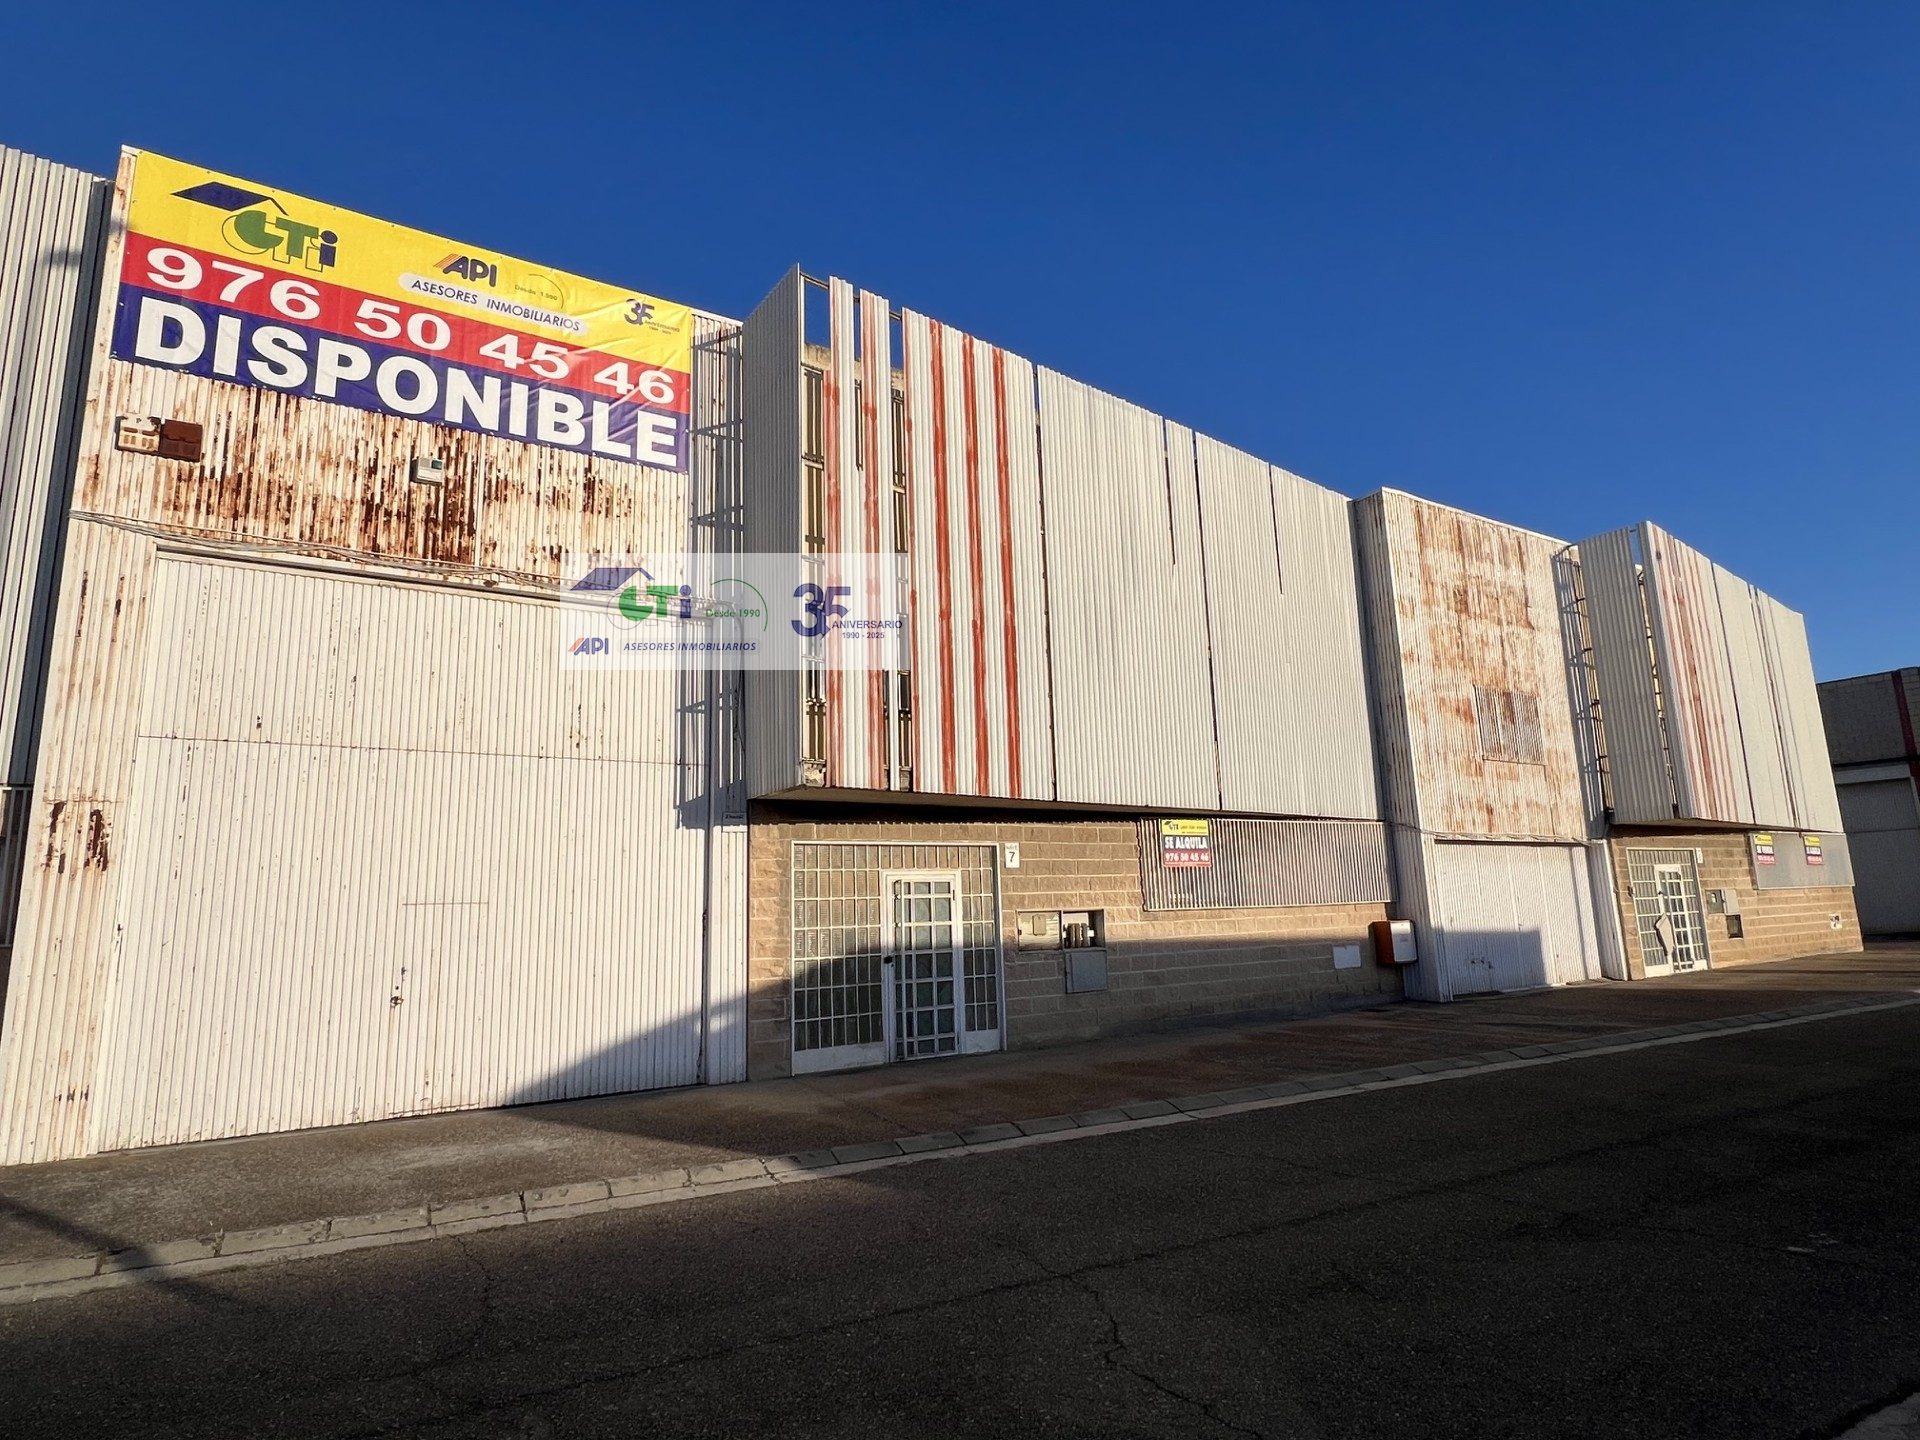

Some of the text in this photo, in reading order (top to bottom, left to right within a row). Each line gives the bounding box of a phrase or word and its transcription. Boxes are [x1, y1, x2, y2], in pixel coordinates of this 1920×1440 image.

[442, 255, 498, 288] API
[411, 279, 581, 332] ASESORES INMOBILIARIOS
[624, 298, 655, 326] 35
[146, 246, 676, 405] 976 50 45 46
[134, 296, 678, 467] DISPONIBLE
[1009, 851, 1015, 862] 7
[1164, 836, 1207, 849] SE ALQUILA
[1165, 853, 1179, 861] 976
